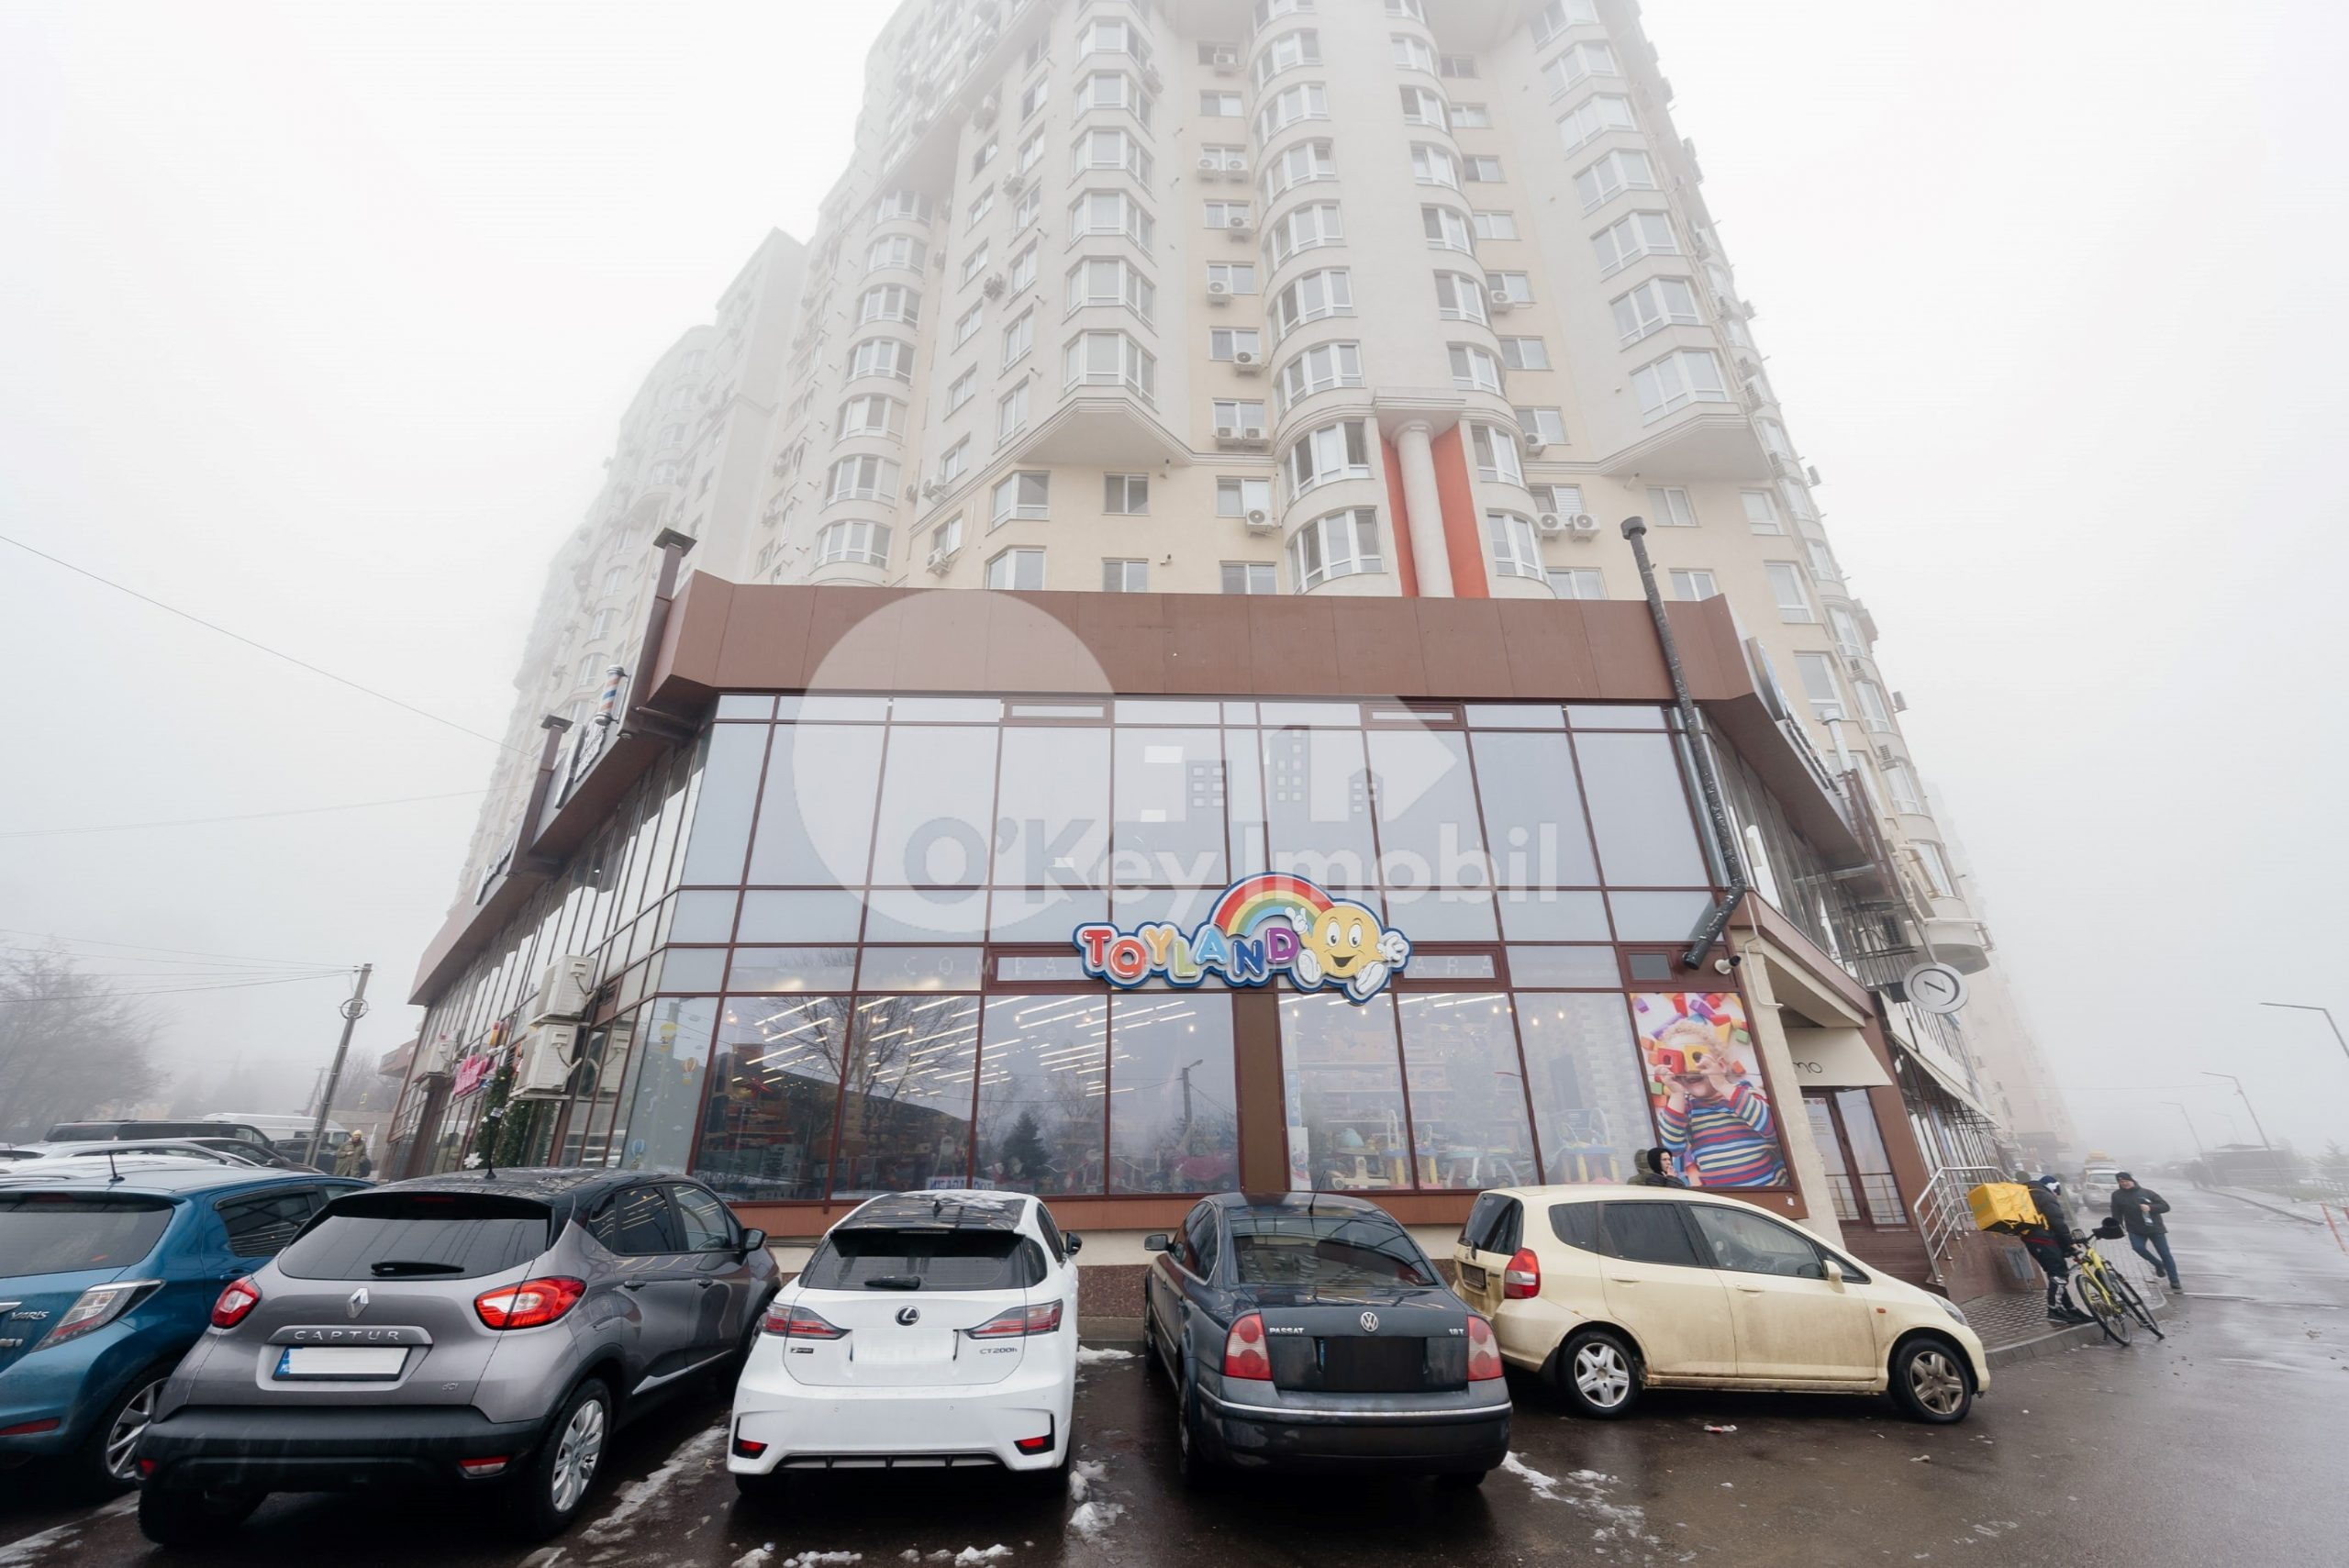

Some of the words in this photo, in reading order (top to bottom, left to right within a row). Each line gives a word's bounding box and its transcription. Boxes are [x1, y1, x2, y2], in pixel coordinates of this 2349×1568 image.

[1082, 927, 1299, 978] TOYLAND
[10, 1310, 50, 1320] YARIS
[294, 1330, 400, 1340] CAPTUR
[1269, 1327, 1304, 1335] PASSAT
